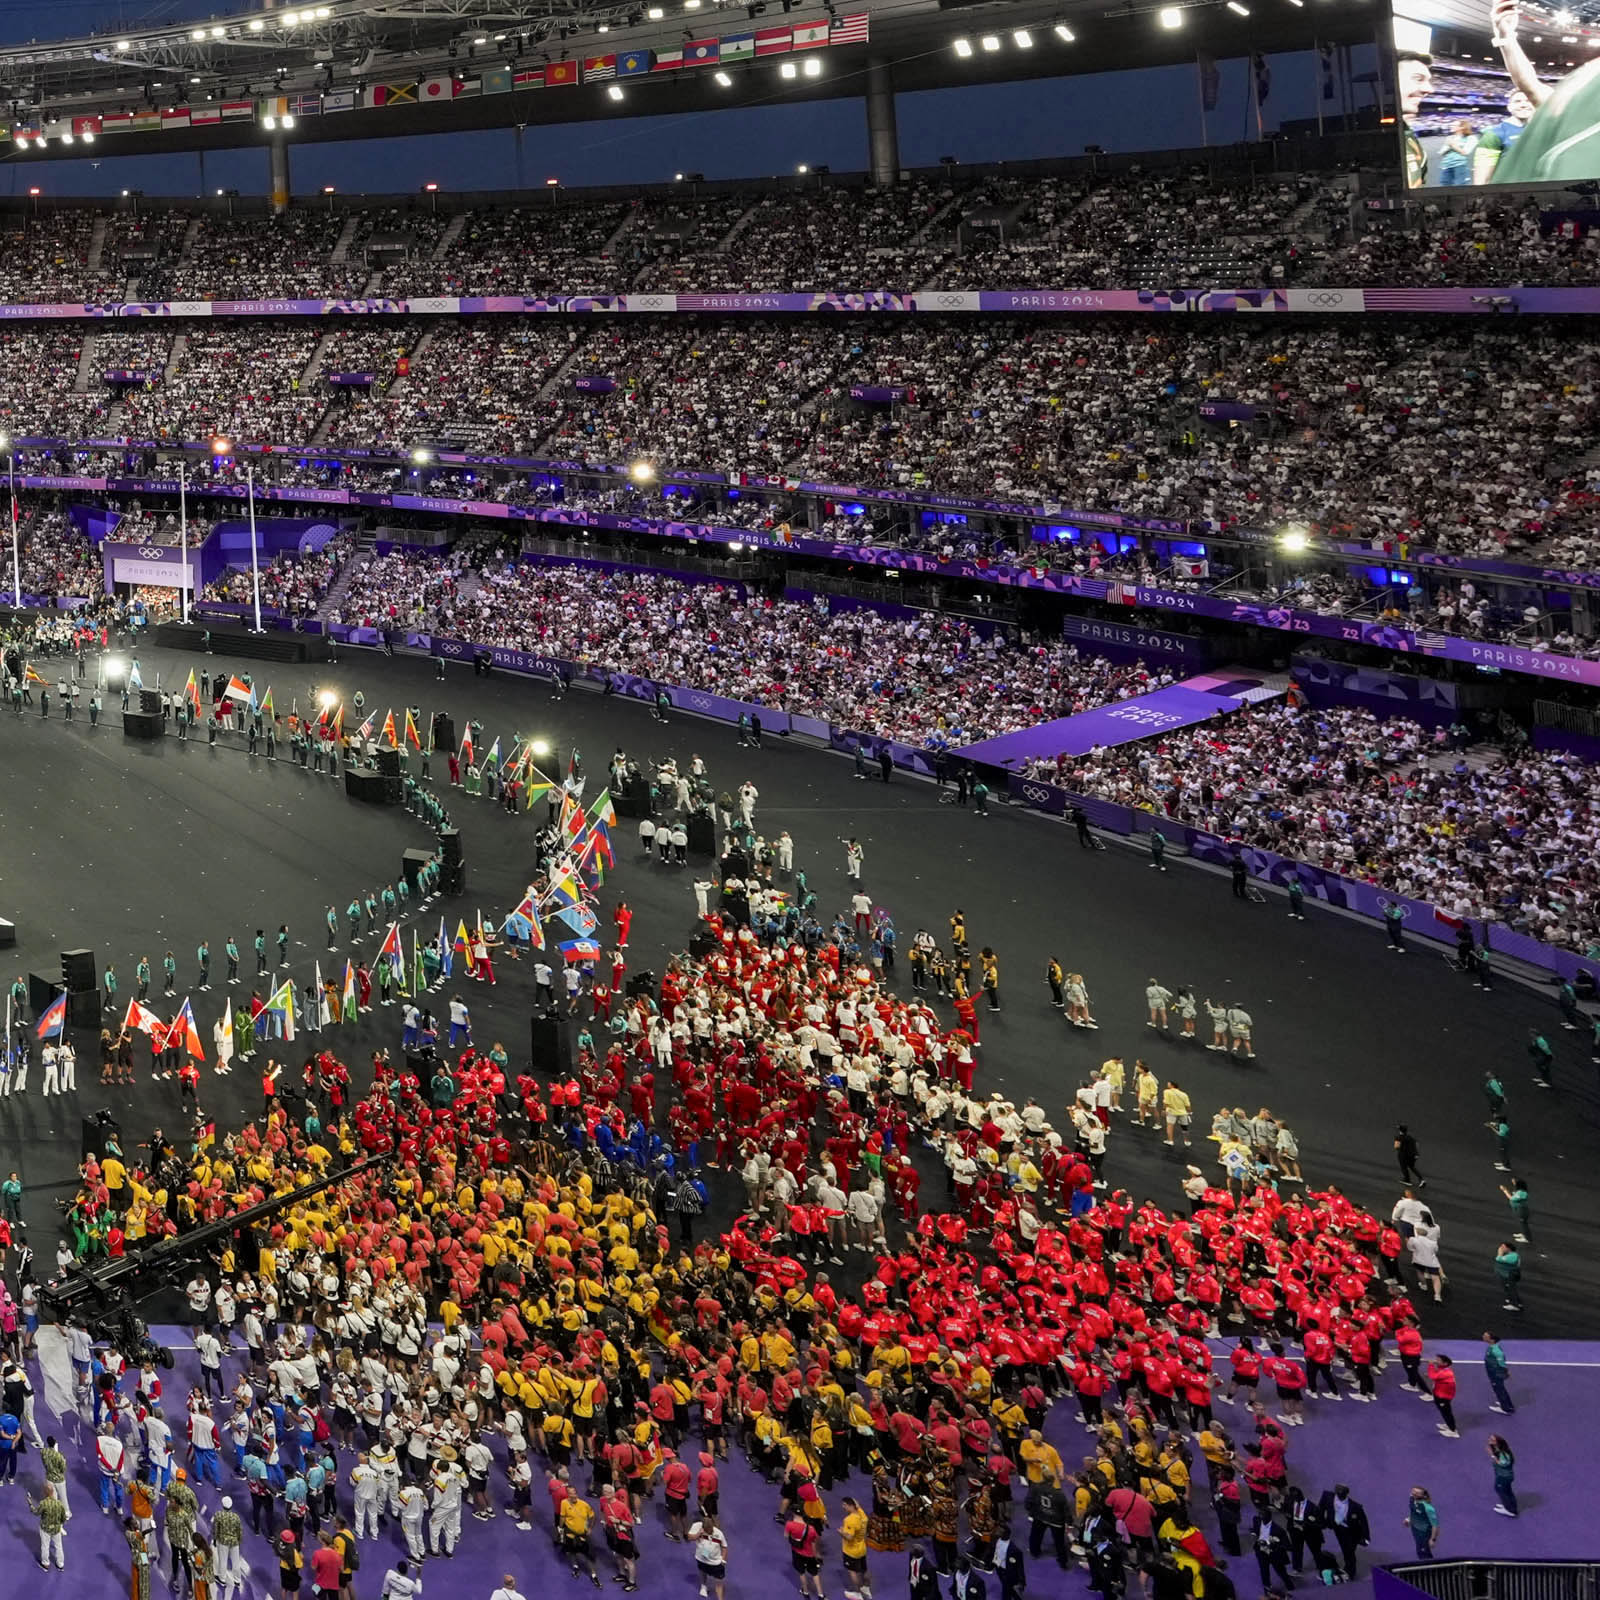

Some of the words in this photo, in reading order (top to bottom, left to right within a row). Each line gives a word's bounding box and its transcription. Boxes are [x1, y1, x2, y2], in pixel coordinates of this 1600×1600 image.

[703, 298, 740, 307] PARIS
[745, 298, 779, 307] 2024
[1011, 295, 1056, 306] PARIS
[1062, 295, 1104, 306] 2024
[4, 307, 34, 316] PARIS
[37, 306, 64, 314] 2024
[234, 304, 264, 312] PARIS
[268, 303, 297, 312] 2024
[288, 491, 315, 499] PARIS
[318, 492, 342, 501] 2024
[422, 501, 449, 510] PARIS
[739, 534, 769, 545] PARIS
[129, 567, 153, 576] PARIS
[961, 567, 975, 577] Z4
[1156, 594, 1194, 609] 2024
[1293, 618, 1311, 631] Z3
[1342, 627, 1360, 640] Z2
[1081, 623, 1131, 642] PARIS
[1137, 633, 1185, 653] 2024
[495, 652, 523, 666] ARIS
[527, 658, 560, 677] 2024
[1472, 647, 1525, 666] PARIS
[1531, 657, 1581, 676] 2024
[1122, 705, 1183, 722] PARIS
